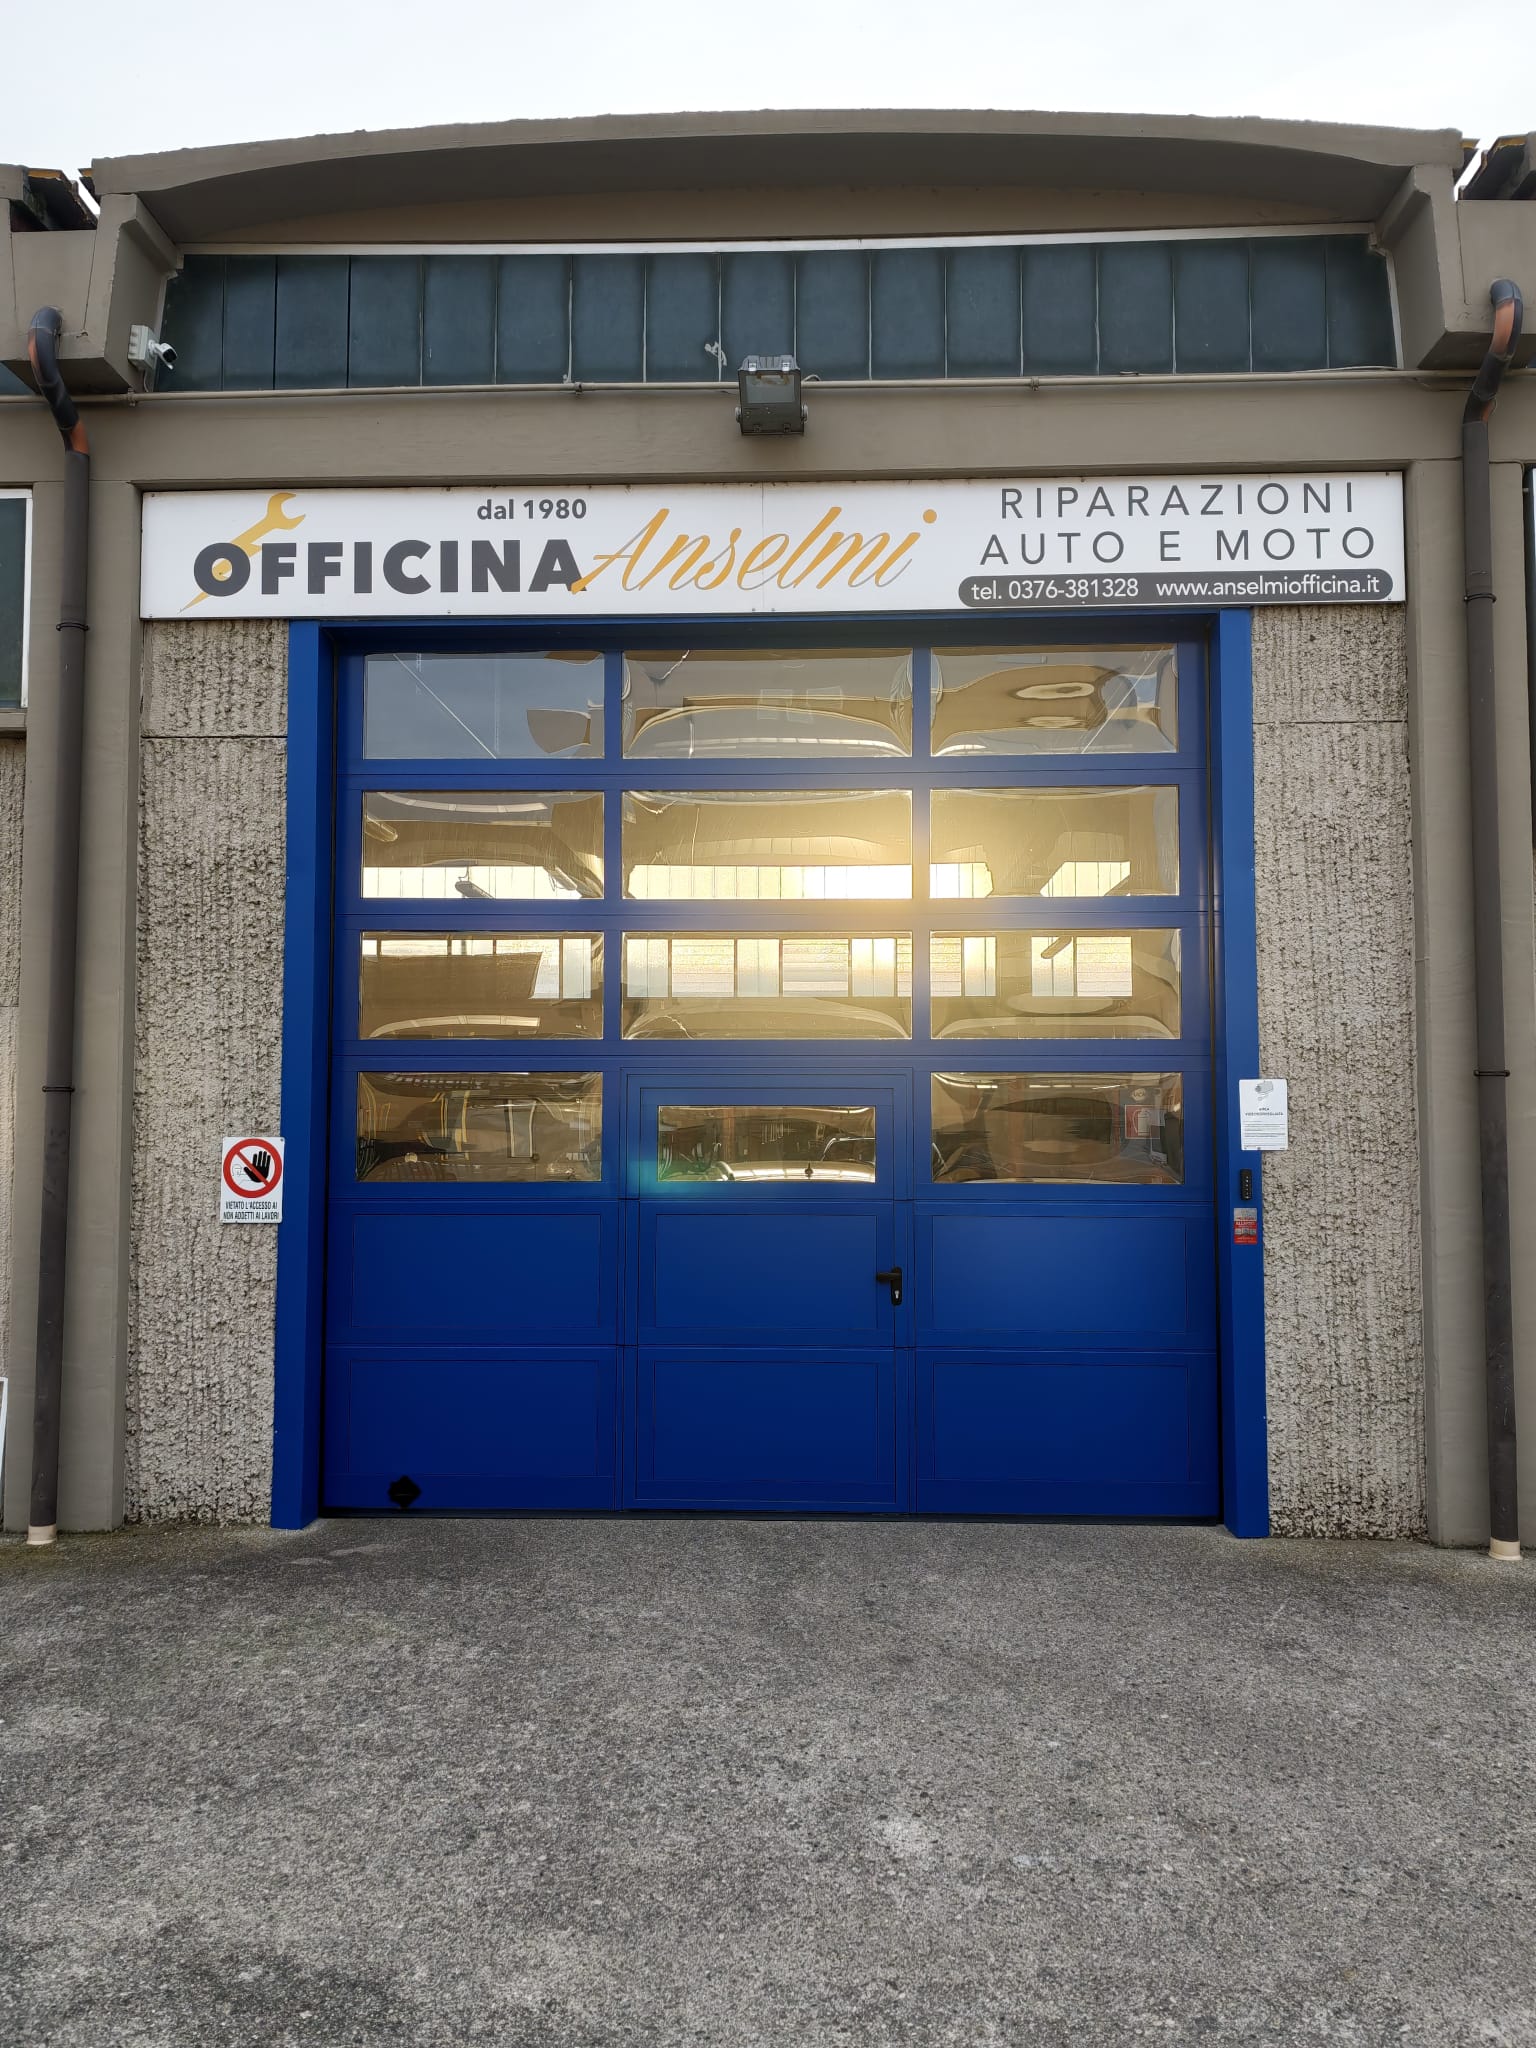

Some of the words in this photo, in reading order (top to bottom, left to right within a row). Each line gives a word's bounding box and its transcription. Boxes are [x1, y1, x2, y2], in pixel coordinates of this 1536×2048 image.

[477, 499, 514, 520] dal
[522, 498, 587, 520] 1980
[1001, 482, 1353, 519] RIPARAZIONI
[193, 539, 587, 597] OFFICINA
[571, 506, 937, 594] Anselmi
[980, 531, 1125, 565] AUTO
[1160, 530, 1181, 562] E
[1216, 526, 1375, 561] MOTO
[971, 584, 1002, 601] tel.
[1008, 578, 1139, 599] 0376-381328
[1156, 574, 1380, 597] www.anselmiofficina.it
[223, 1211, 234, 1220] NON
[234, 1211, 255, 1220] ADDETTI
[255, 1211, 261, 1220] AI
[261, 1211, 280, 1220] LAVORI
[225, 1201, 245, 1210] VIETATO
[245, 1201, 271, 1210] L'ACCESSO
[272, 1201, 278, 1210] AI
